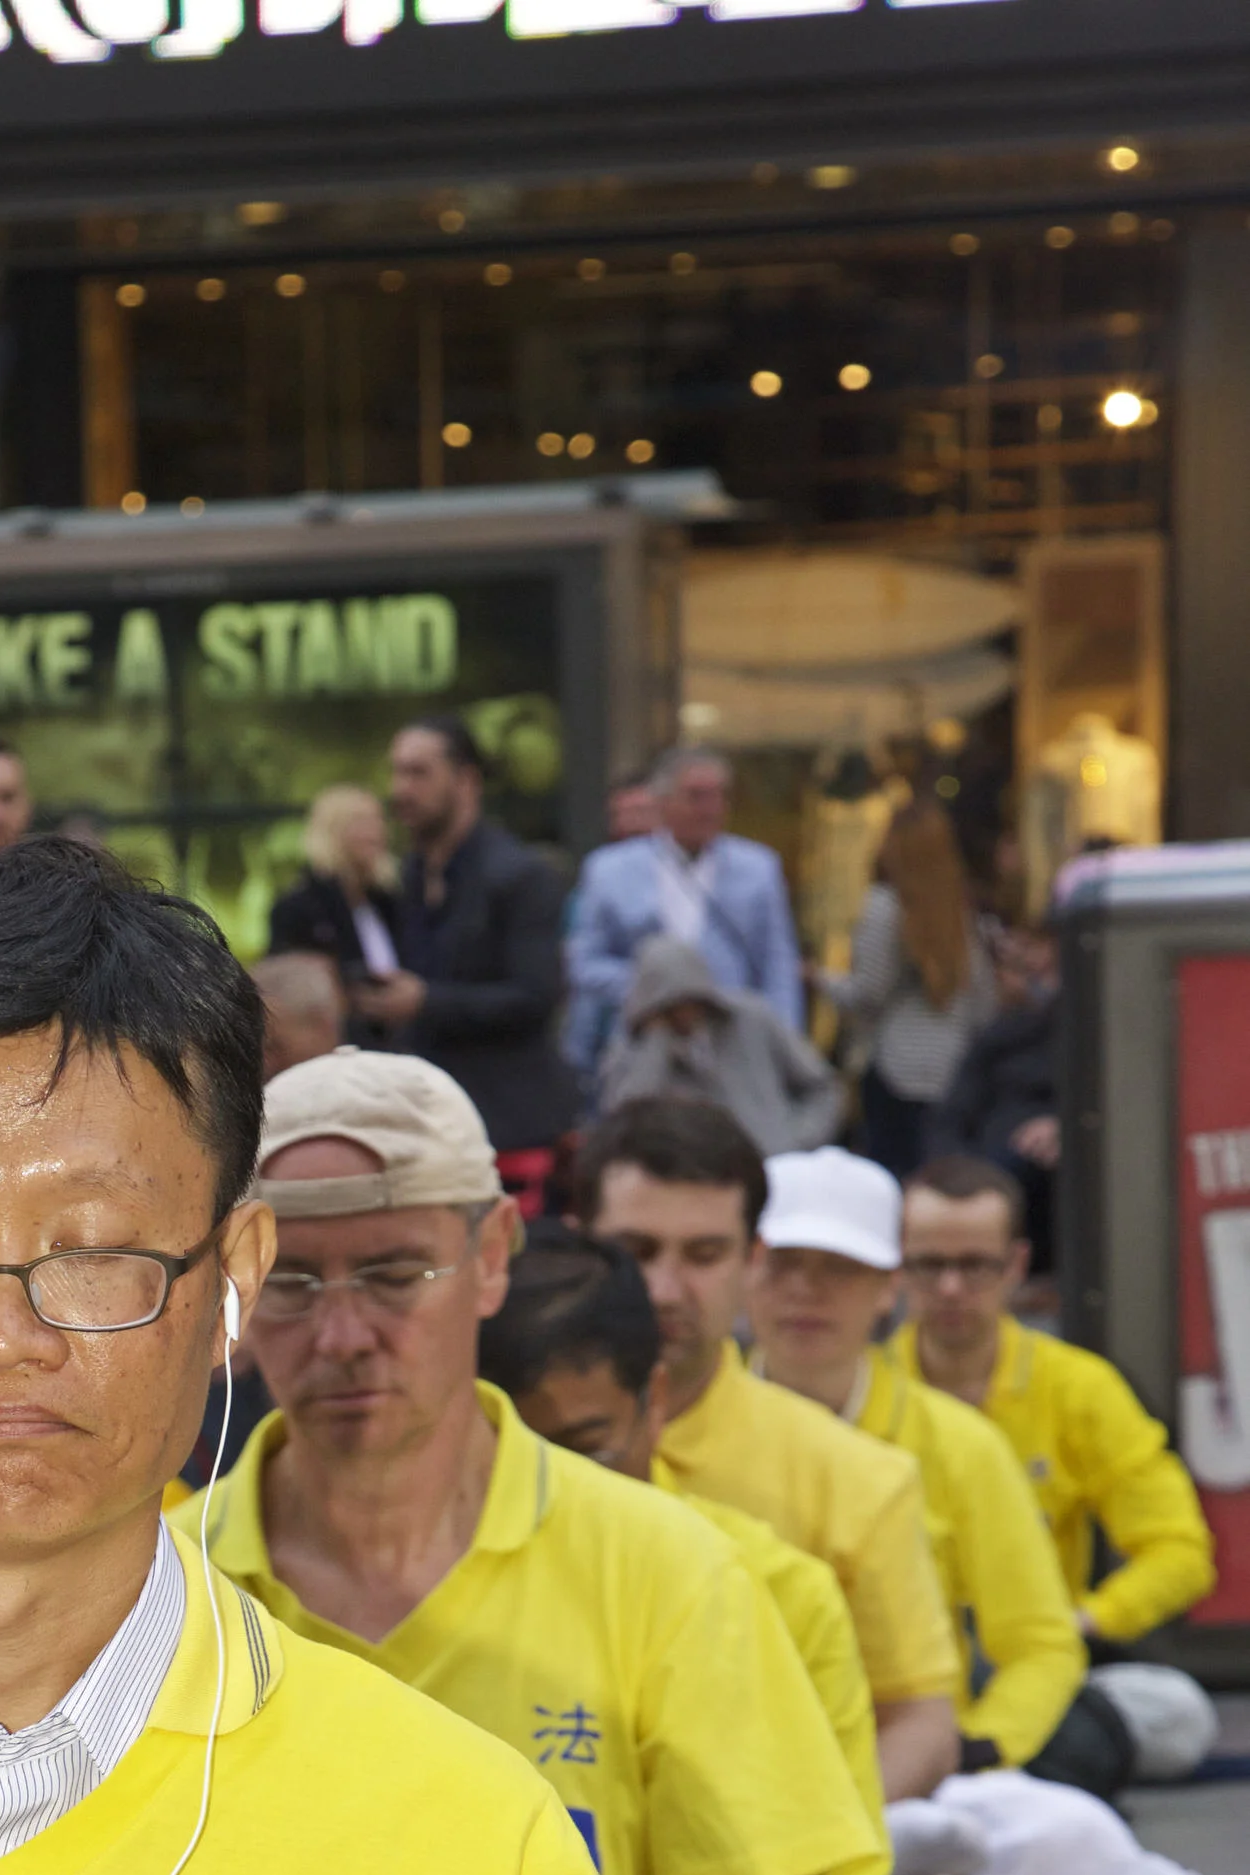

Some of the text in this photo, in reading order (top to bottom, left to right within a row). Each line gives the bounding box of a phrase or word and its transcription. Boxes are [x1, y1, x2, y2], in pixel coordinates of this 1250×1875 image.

[115, 607, 168, 706] A
[197, 592, 457, 699] STAND
[533, 1701, 601, 1765] 法
